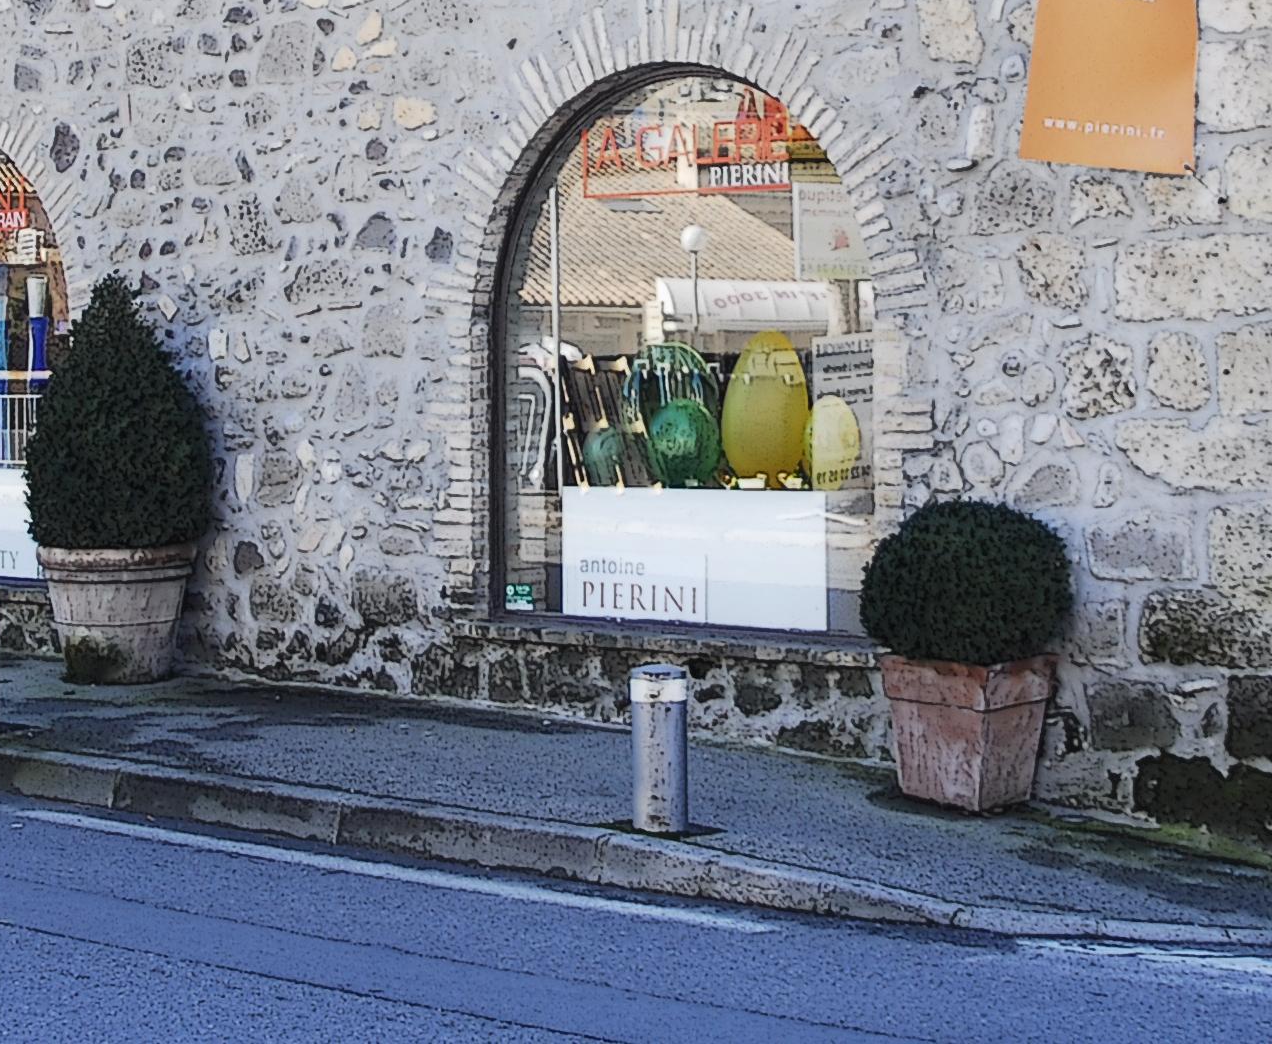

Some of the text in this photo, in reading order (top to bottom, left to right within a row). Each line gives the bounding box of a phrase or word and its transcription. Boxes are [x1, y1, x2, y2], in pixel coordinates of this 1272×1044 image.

[1042, 117, 1166, 140] www.pierini.fr
[710, 161, 790, 189] PIERINI
[580, 556, 645, 575] antoine
[583, 581, 696, 614] PIERINI
